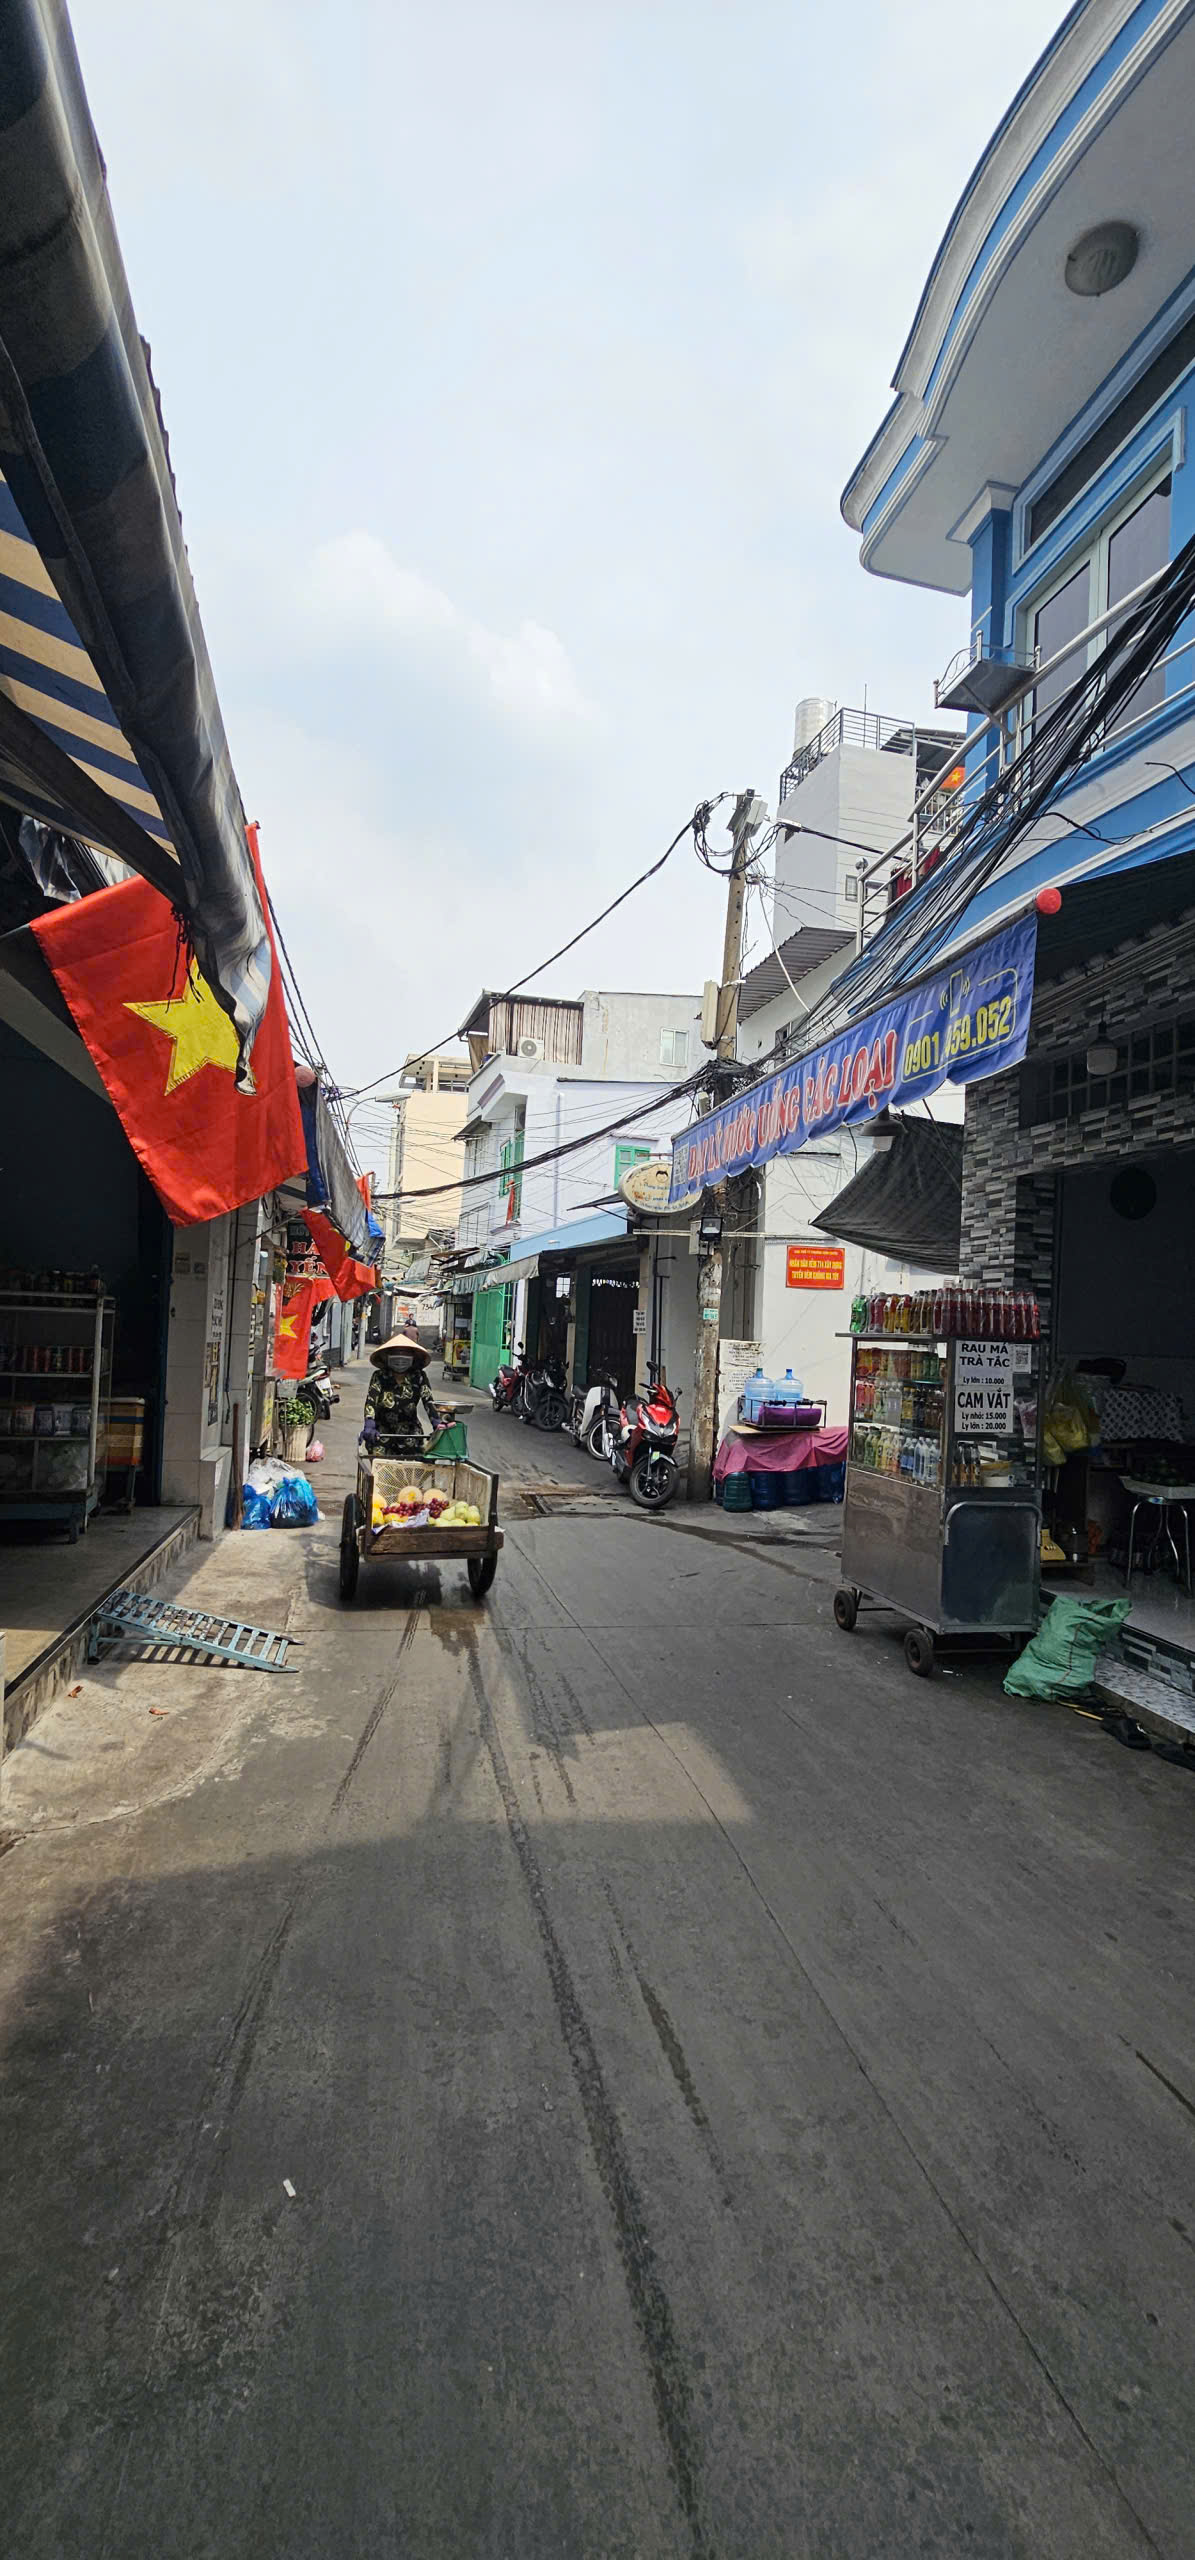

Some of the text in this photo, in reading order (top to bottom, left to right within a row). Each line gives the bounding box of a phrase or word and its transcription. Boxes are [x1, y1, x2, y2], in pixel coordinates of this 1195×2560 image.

[803, 1058, 838, 1125] CÁC
[837, 1029, 898, 1110] LOẠI
[961, 1342, 1008, 1354] RAU MÁ
[960, 1354, 983, 1366] TRÀ
[957, 1388, 1011, 1409] CAM VẮT
[962, 1412, 969, 1421] Ly
[985, 1412, 1007, 1420] 15.000
[962, 1422, 969, 1431] Ly
[985, 1422, 1007, 1430] 20.000
